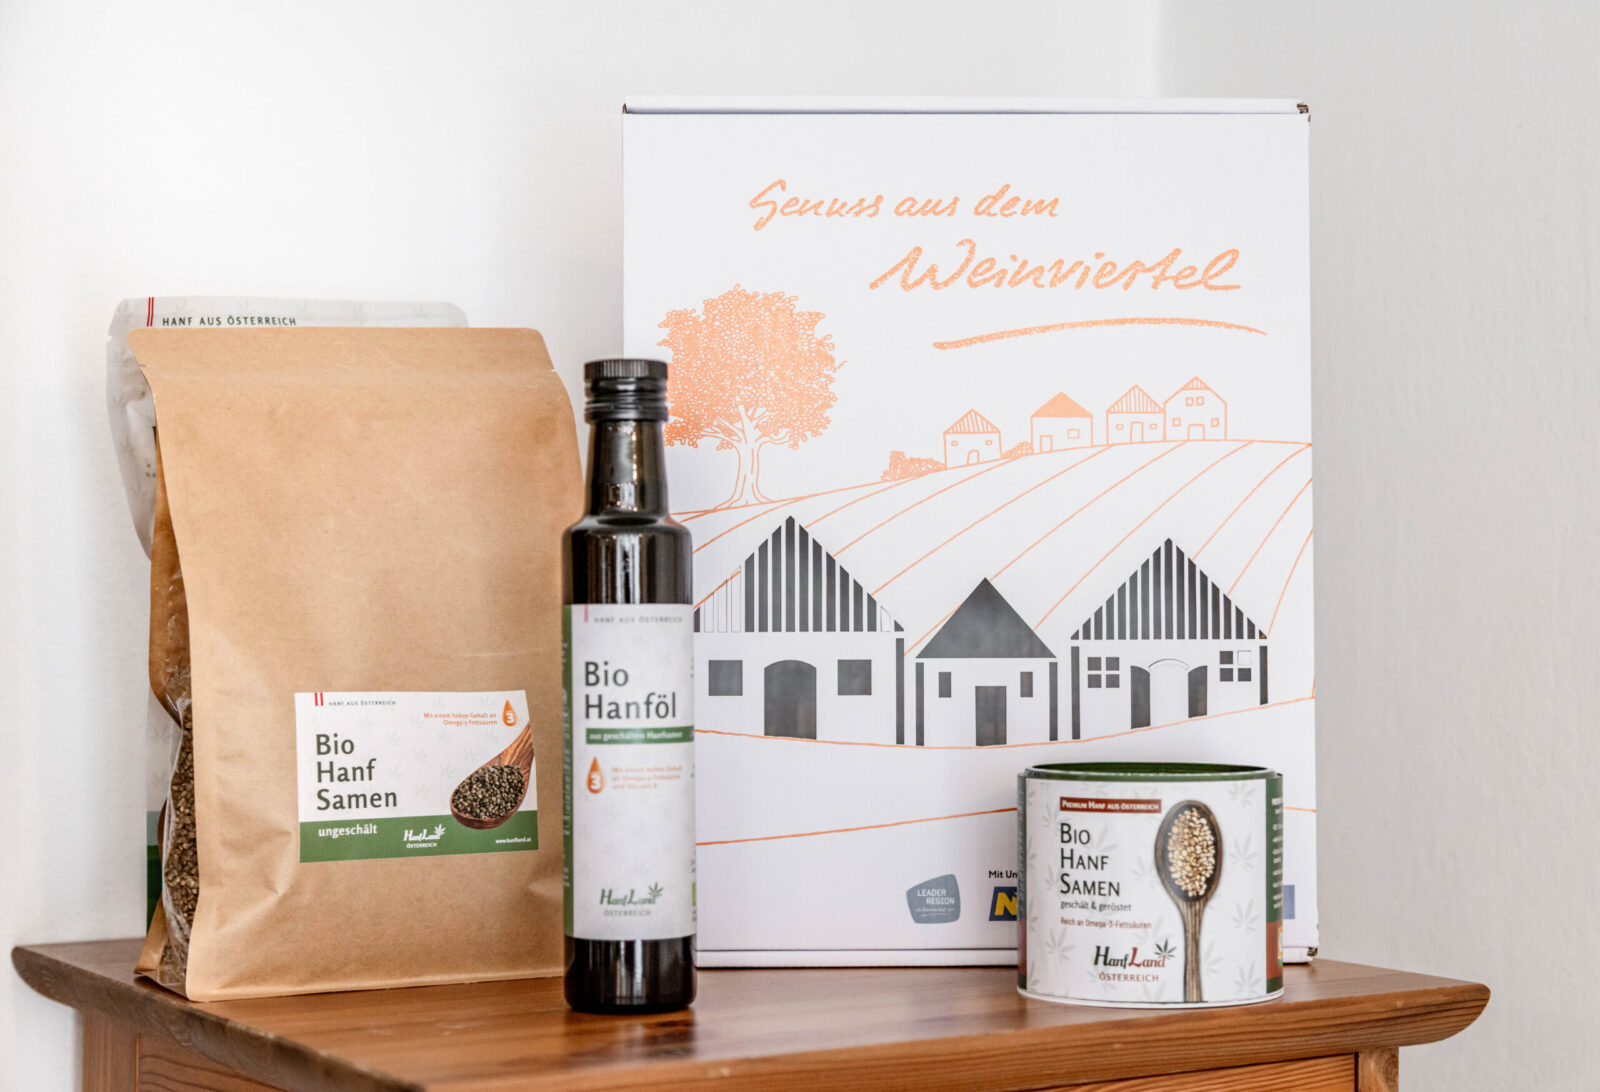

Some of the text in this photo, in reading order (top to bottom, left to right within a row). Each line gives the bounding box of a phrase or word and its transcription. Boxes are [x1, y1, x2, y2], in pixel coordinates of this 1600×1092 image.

[748, 178, 1060, 231] Genuss aus dem
[869, 238, 1242, 292] Weinviertel
[162, 314, 297, 326] HANF AUS ÖSTERREICH
[585, 661, 629, 687] Bio
[585, 692, 676, 720] Hanföl
[505, 711, 515, 724] 3
[315, 733, 355, 756] Bio
[316, 758, 377, 783] Hanf
[590, 772, 601, 789] 3
[316, 788, 398, 811] Samen
[318, 824, 377, 839] ungeschält
[1060, 823, 1090, 845] BIO
[1060, 849, 1109, 871] HANF
[988, 870, 1018, 879] Mit Un
[917, 888, 947, 897] LEADER
[1060, 873, 1120, 897] SAMEN
[926, 897, 955, 905] REGION
[1060, 900, 1132, 912] geschält & geröstet
[1060, 917, 1076, 925] Reich
[1098, 971, 1159, 982] ÖSTERREICH
